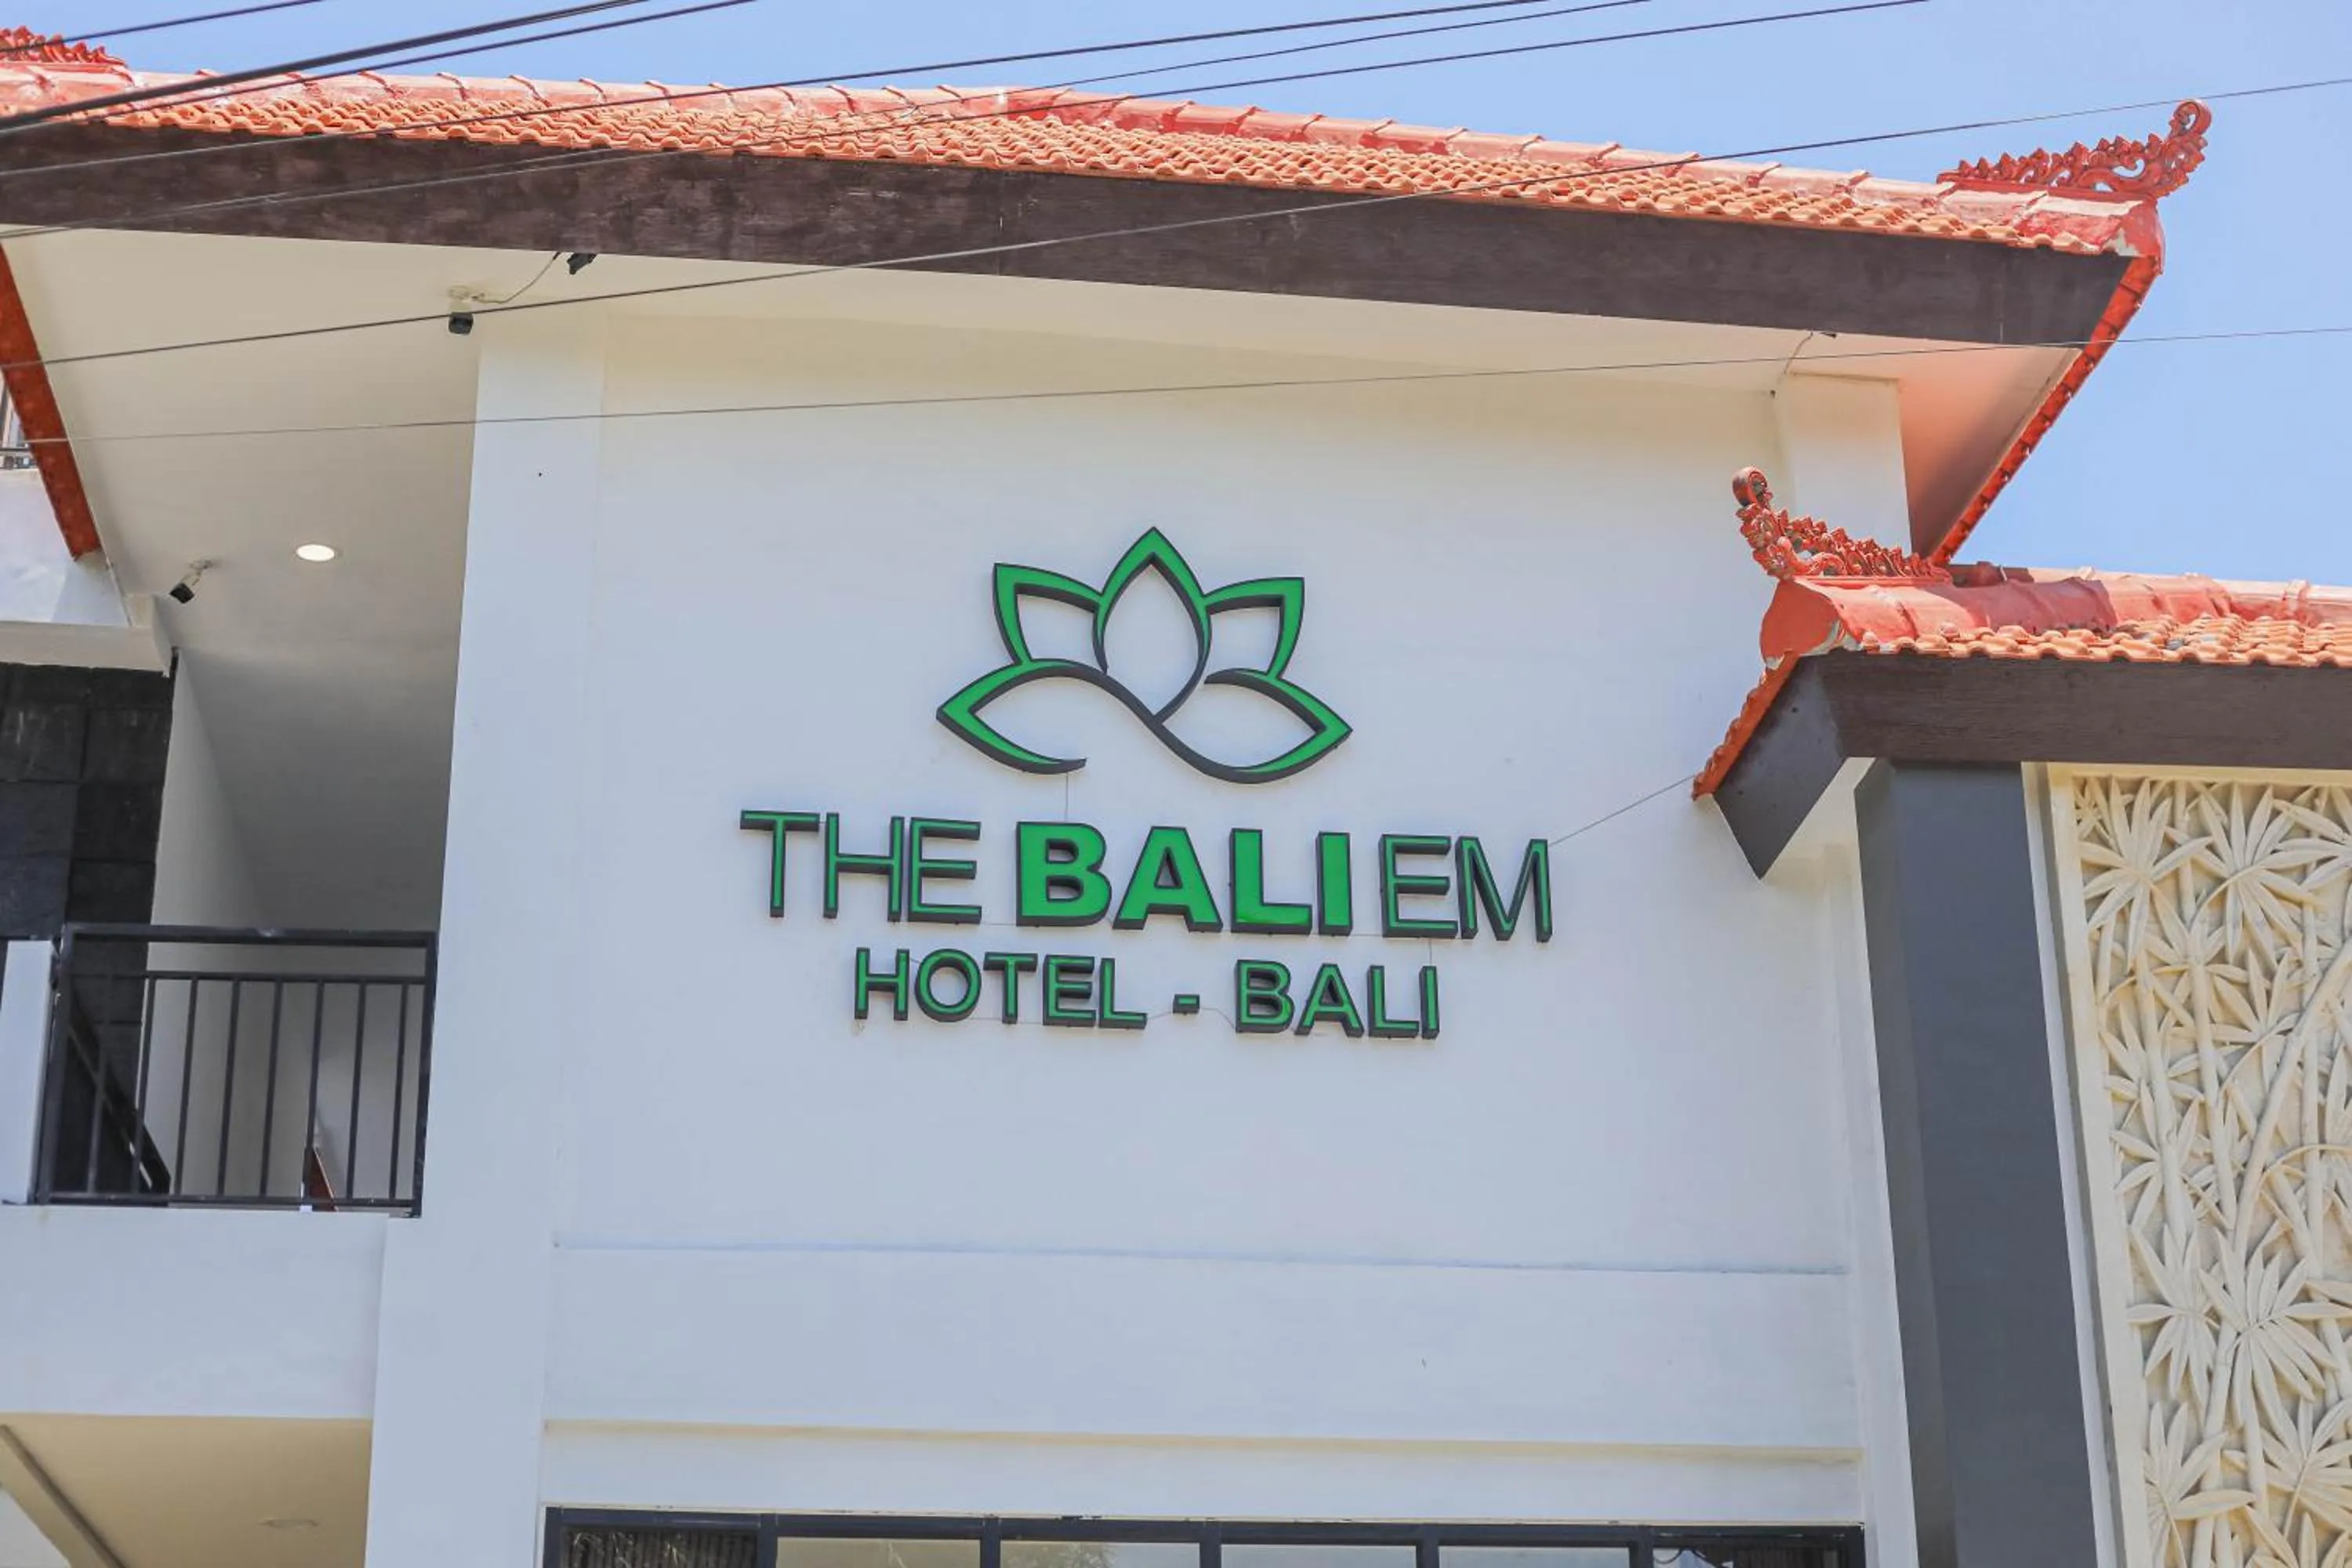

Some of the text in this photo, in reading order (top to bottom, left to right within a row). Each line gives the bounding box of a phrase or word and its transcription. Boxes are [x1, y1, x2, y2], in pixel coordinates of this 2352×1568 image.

[740, 810, 1552, 943] THE BALIEM
[855, 948, 1147, 1030] HOTEL
[1235, 960, 1439, 1040] BALI
